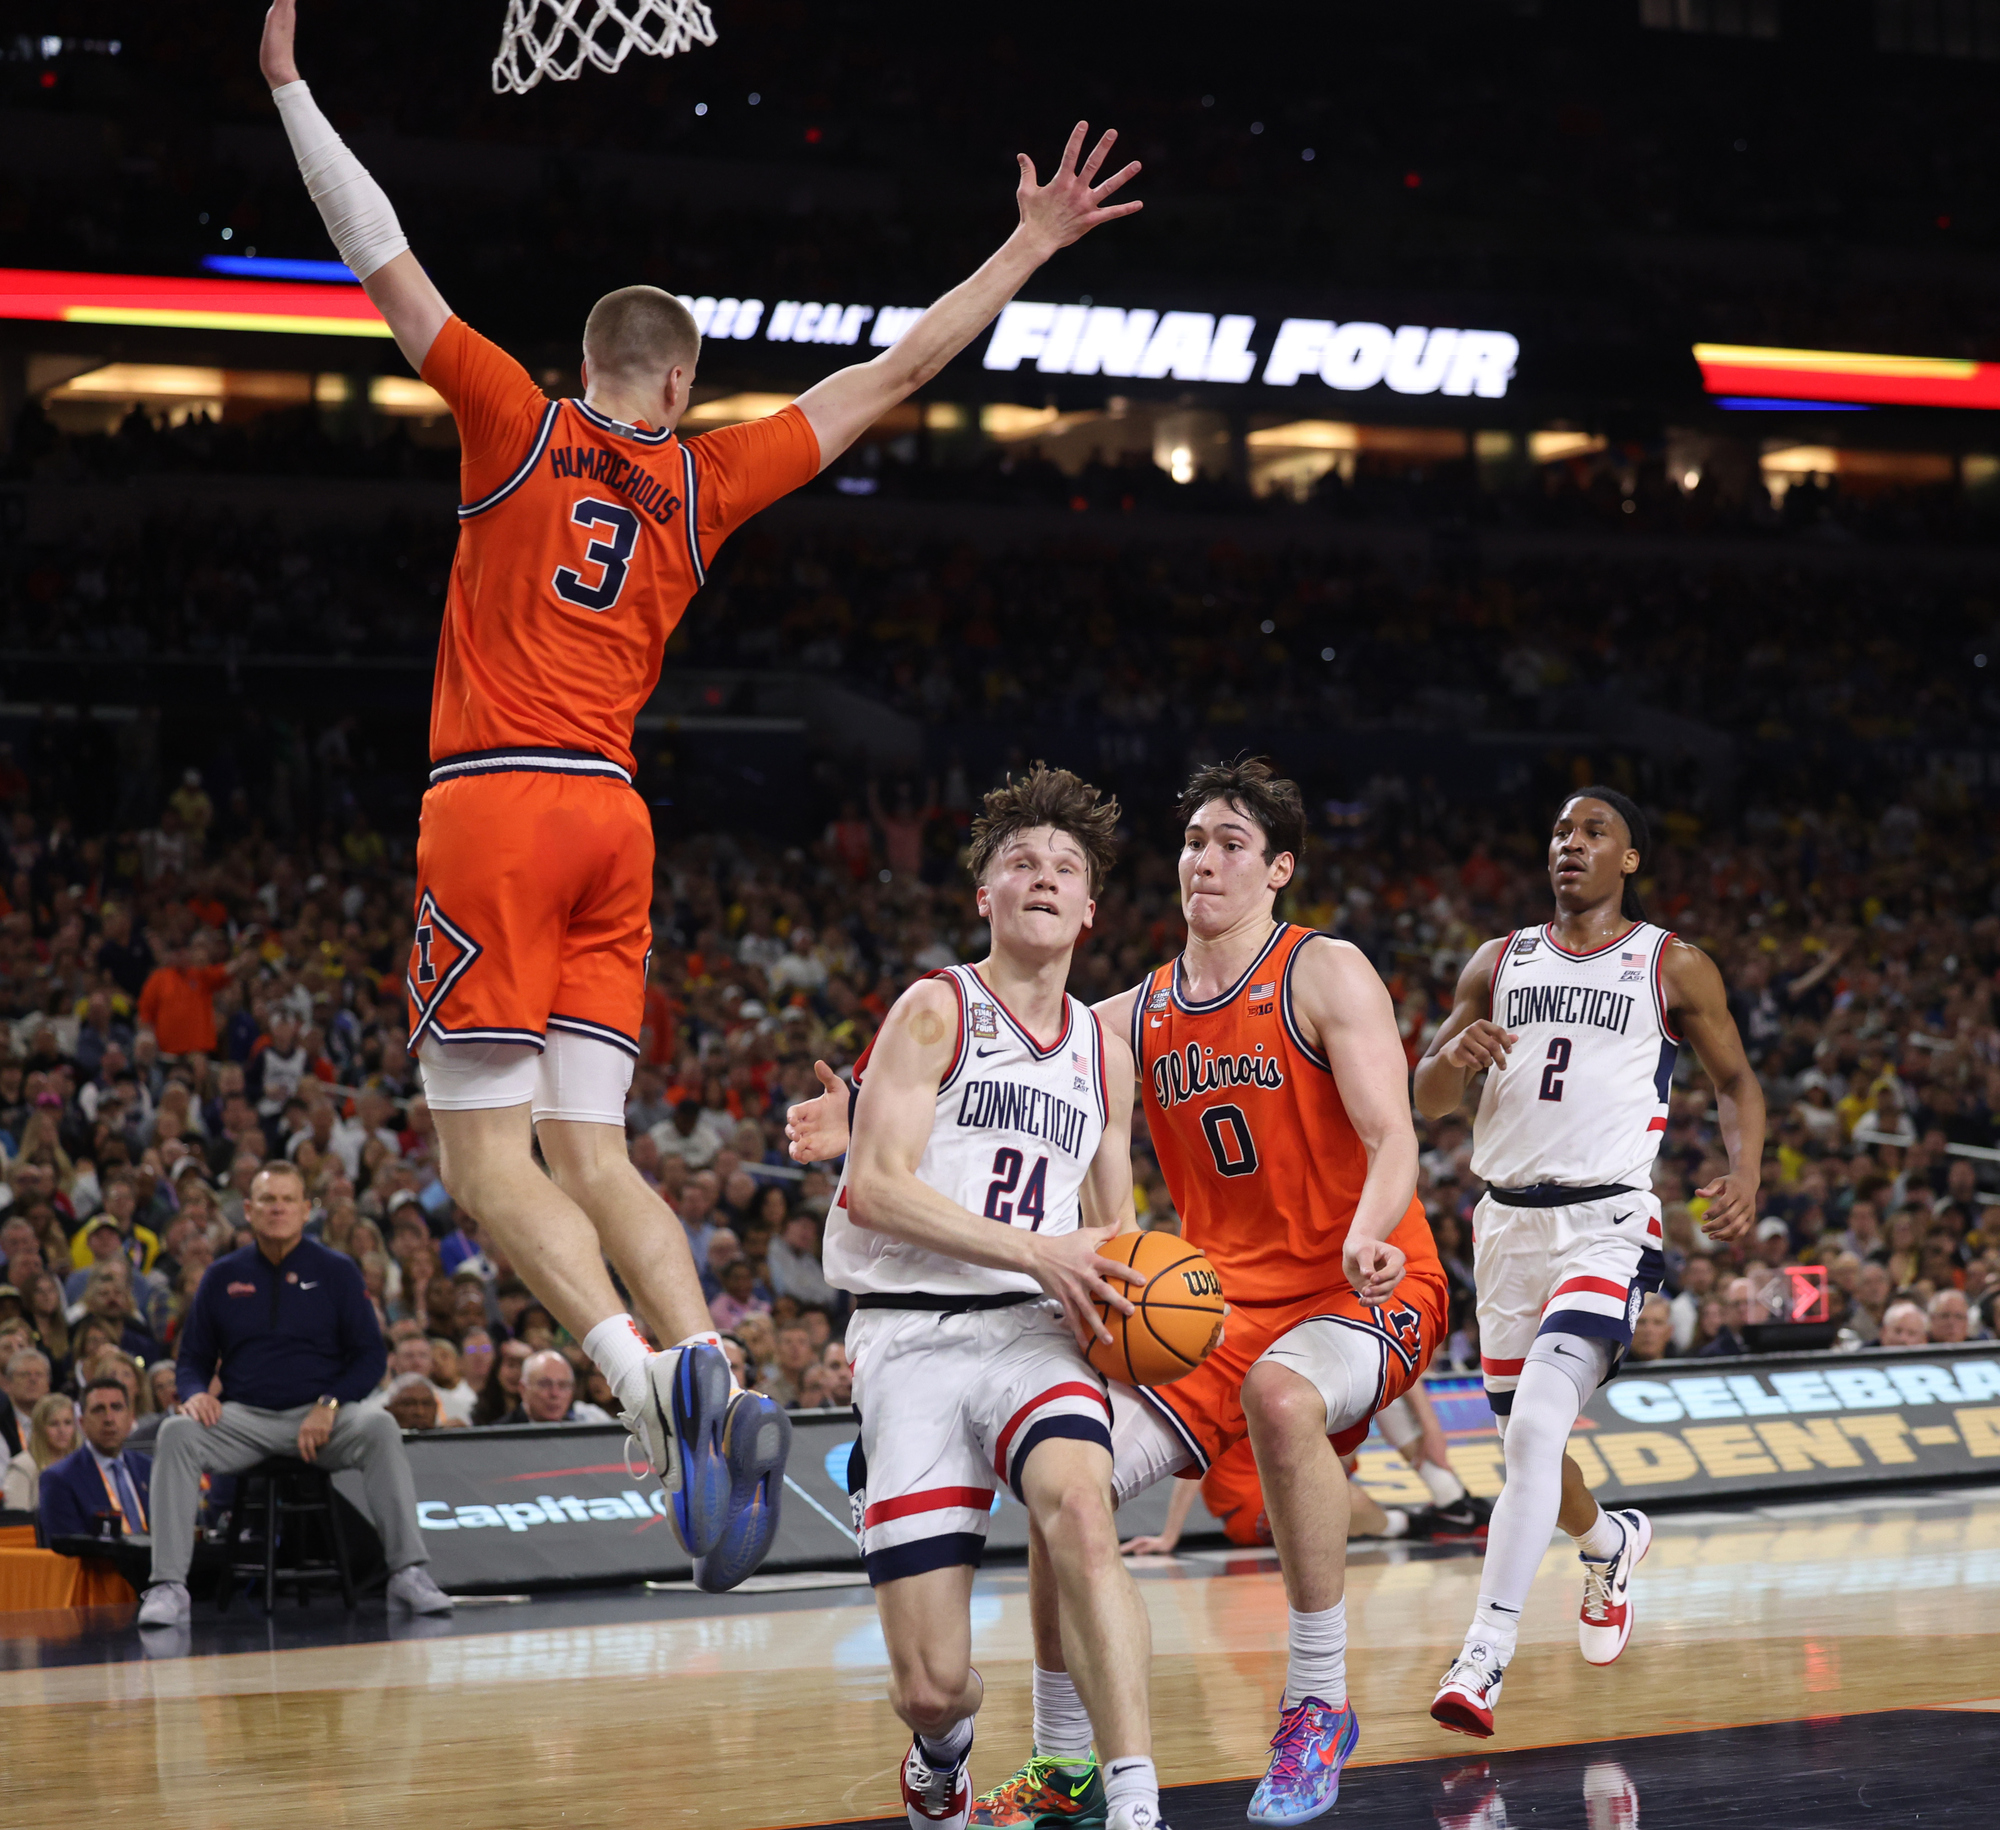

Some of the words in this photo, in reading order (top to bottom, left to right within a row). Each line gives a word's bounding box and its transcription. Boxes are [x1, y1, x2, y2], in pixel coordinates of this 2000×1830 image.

[983, 300, 1256, 383] FINAL
[1262, 317, 1519, 397] FOUR
[551, 446, 682, 525] HUMRICHOUS
[551, 496, 641, 612] 3
[1507, 985, 1635, 1035] CONNECTICUT
[1152, 1042, 1284, 1110] Illinois
[1538, 1037, 1572, 1102] 2
[957, 1080, 1088, 1159] CONNECTICUT
[1200, 1103, 1259, 1178] 0
[983, 1147, 1049, 1231] 24
[416, 1490, 654, 1532] Capital
